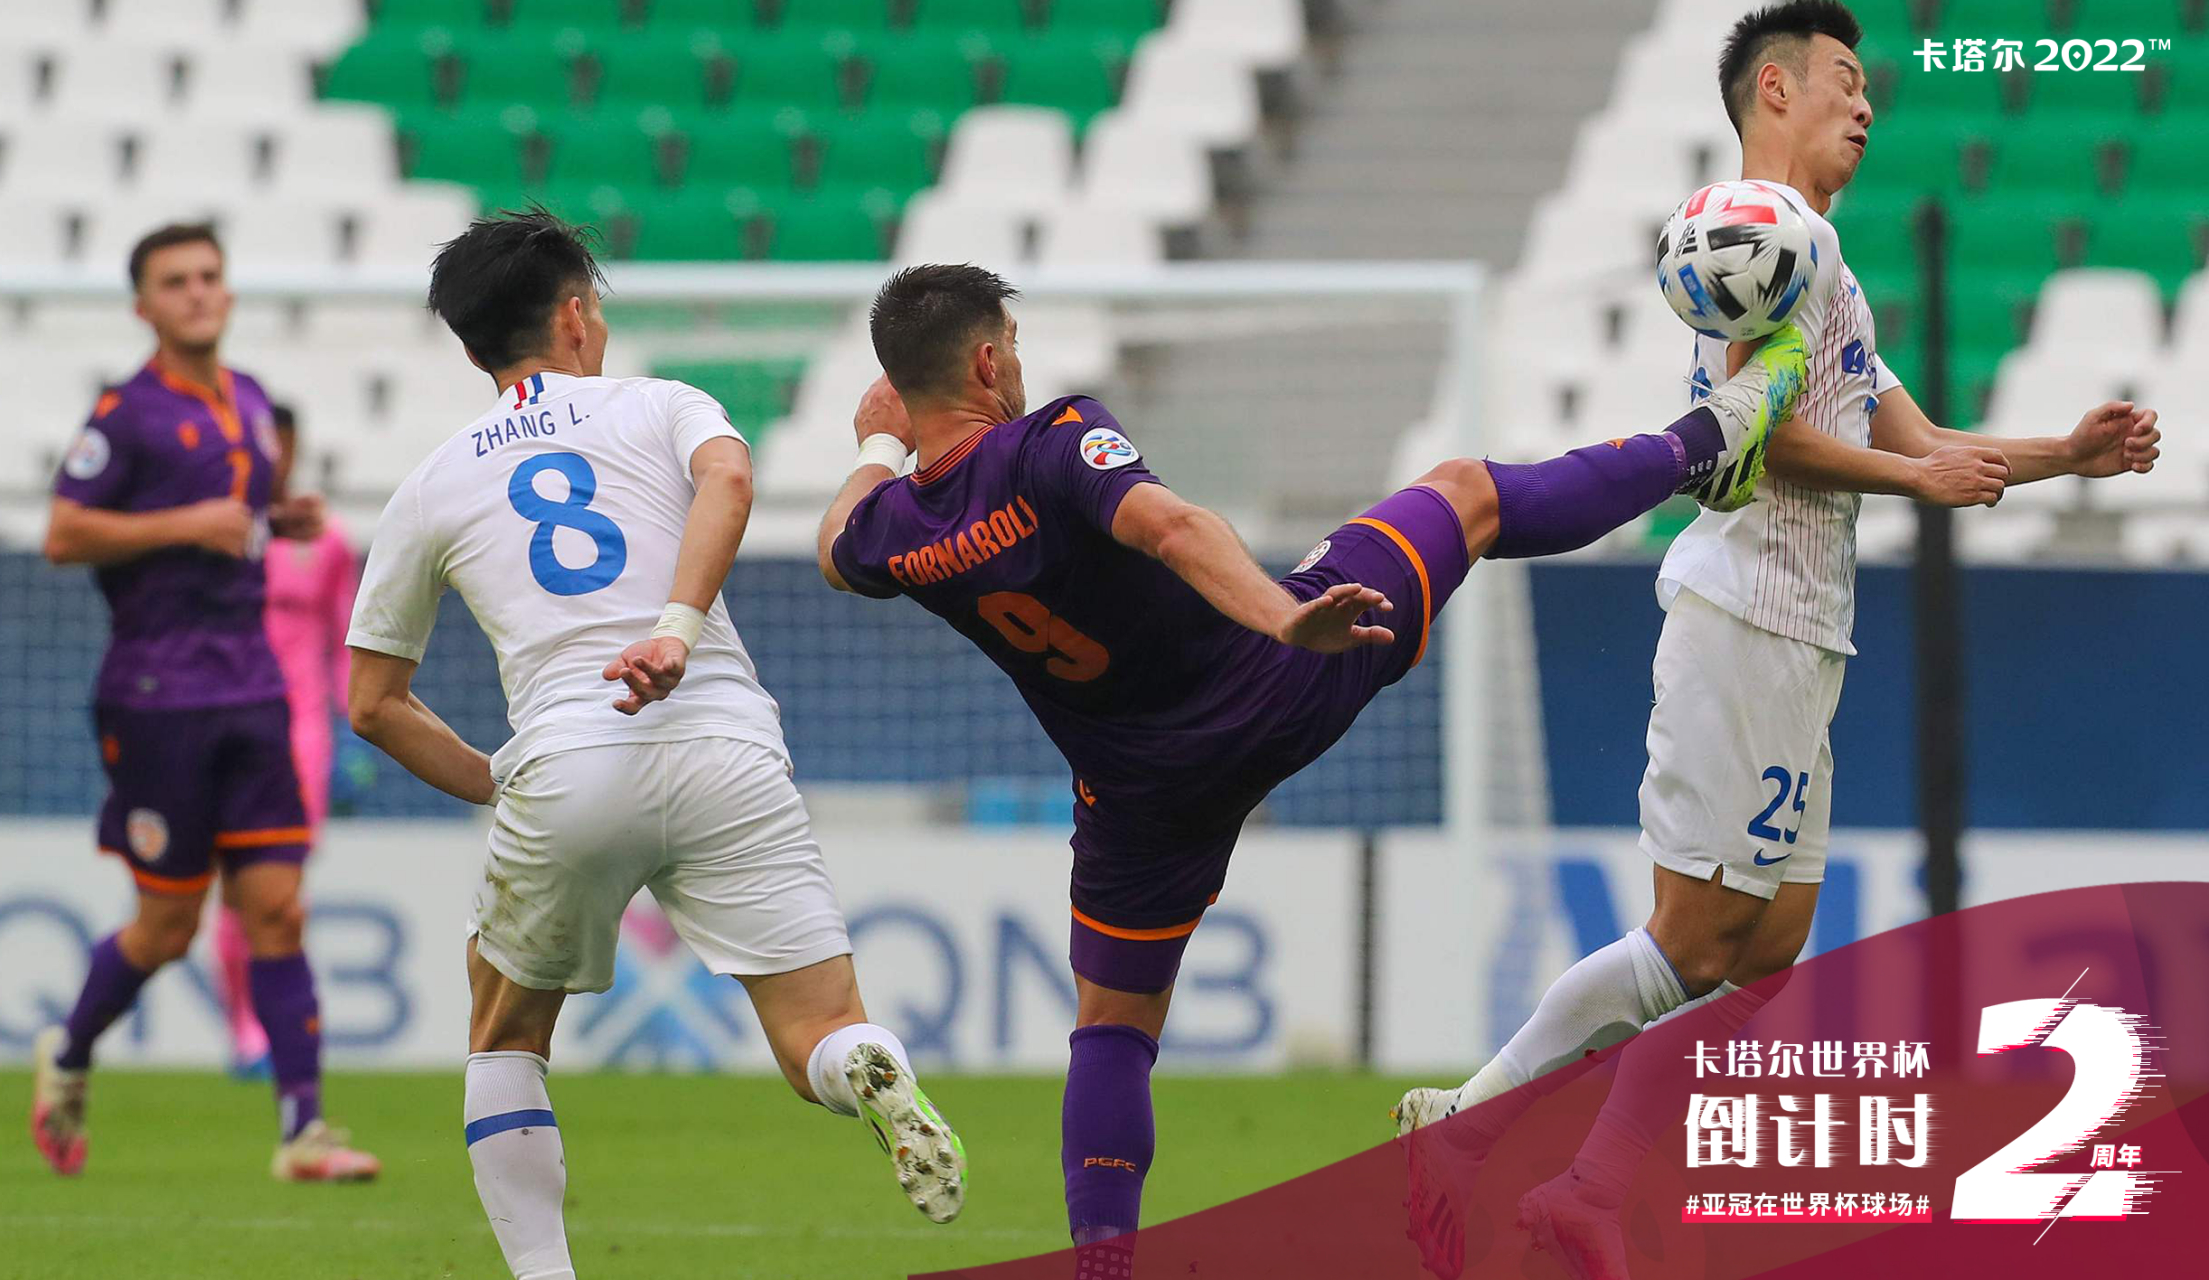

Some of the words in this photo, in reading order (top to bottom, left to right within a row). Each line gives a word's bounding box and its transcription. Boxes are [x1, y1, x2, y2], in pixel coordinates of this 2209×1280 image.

[472, 411, 556, 458] ZHANG
[569, 402, 590, 426] L.
[508, 452, 627, 596] 8
[888, 495, 1039, 587] FORNAROLI
[978, 591, 1110, 682] 9
[1747, 766, 1808, 844] 25
[837, 903, 1275, 1052] QNB
[1083, 1157, 1136, 1172] PGFC
